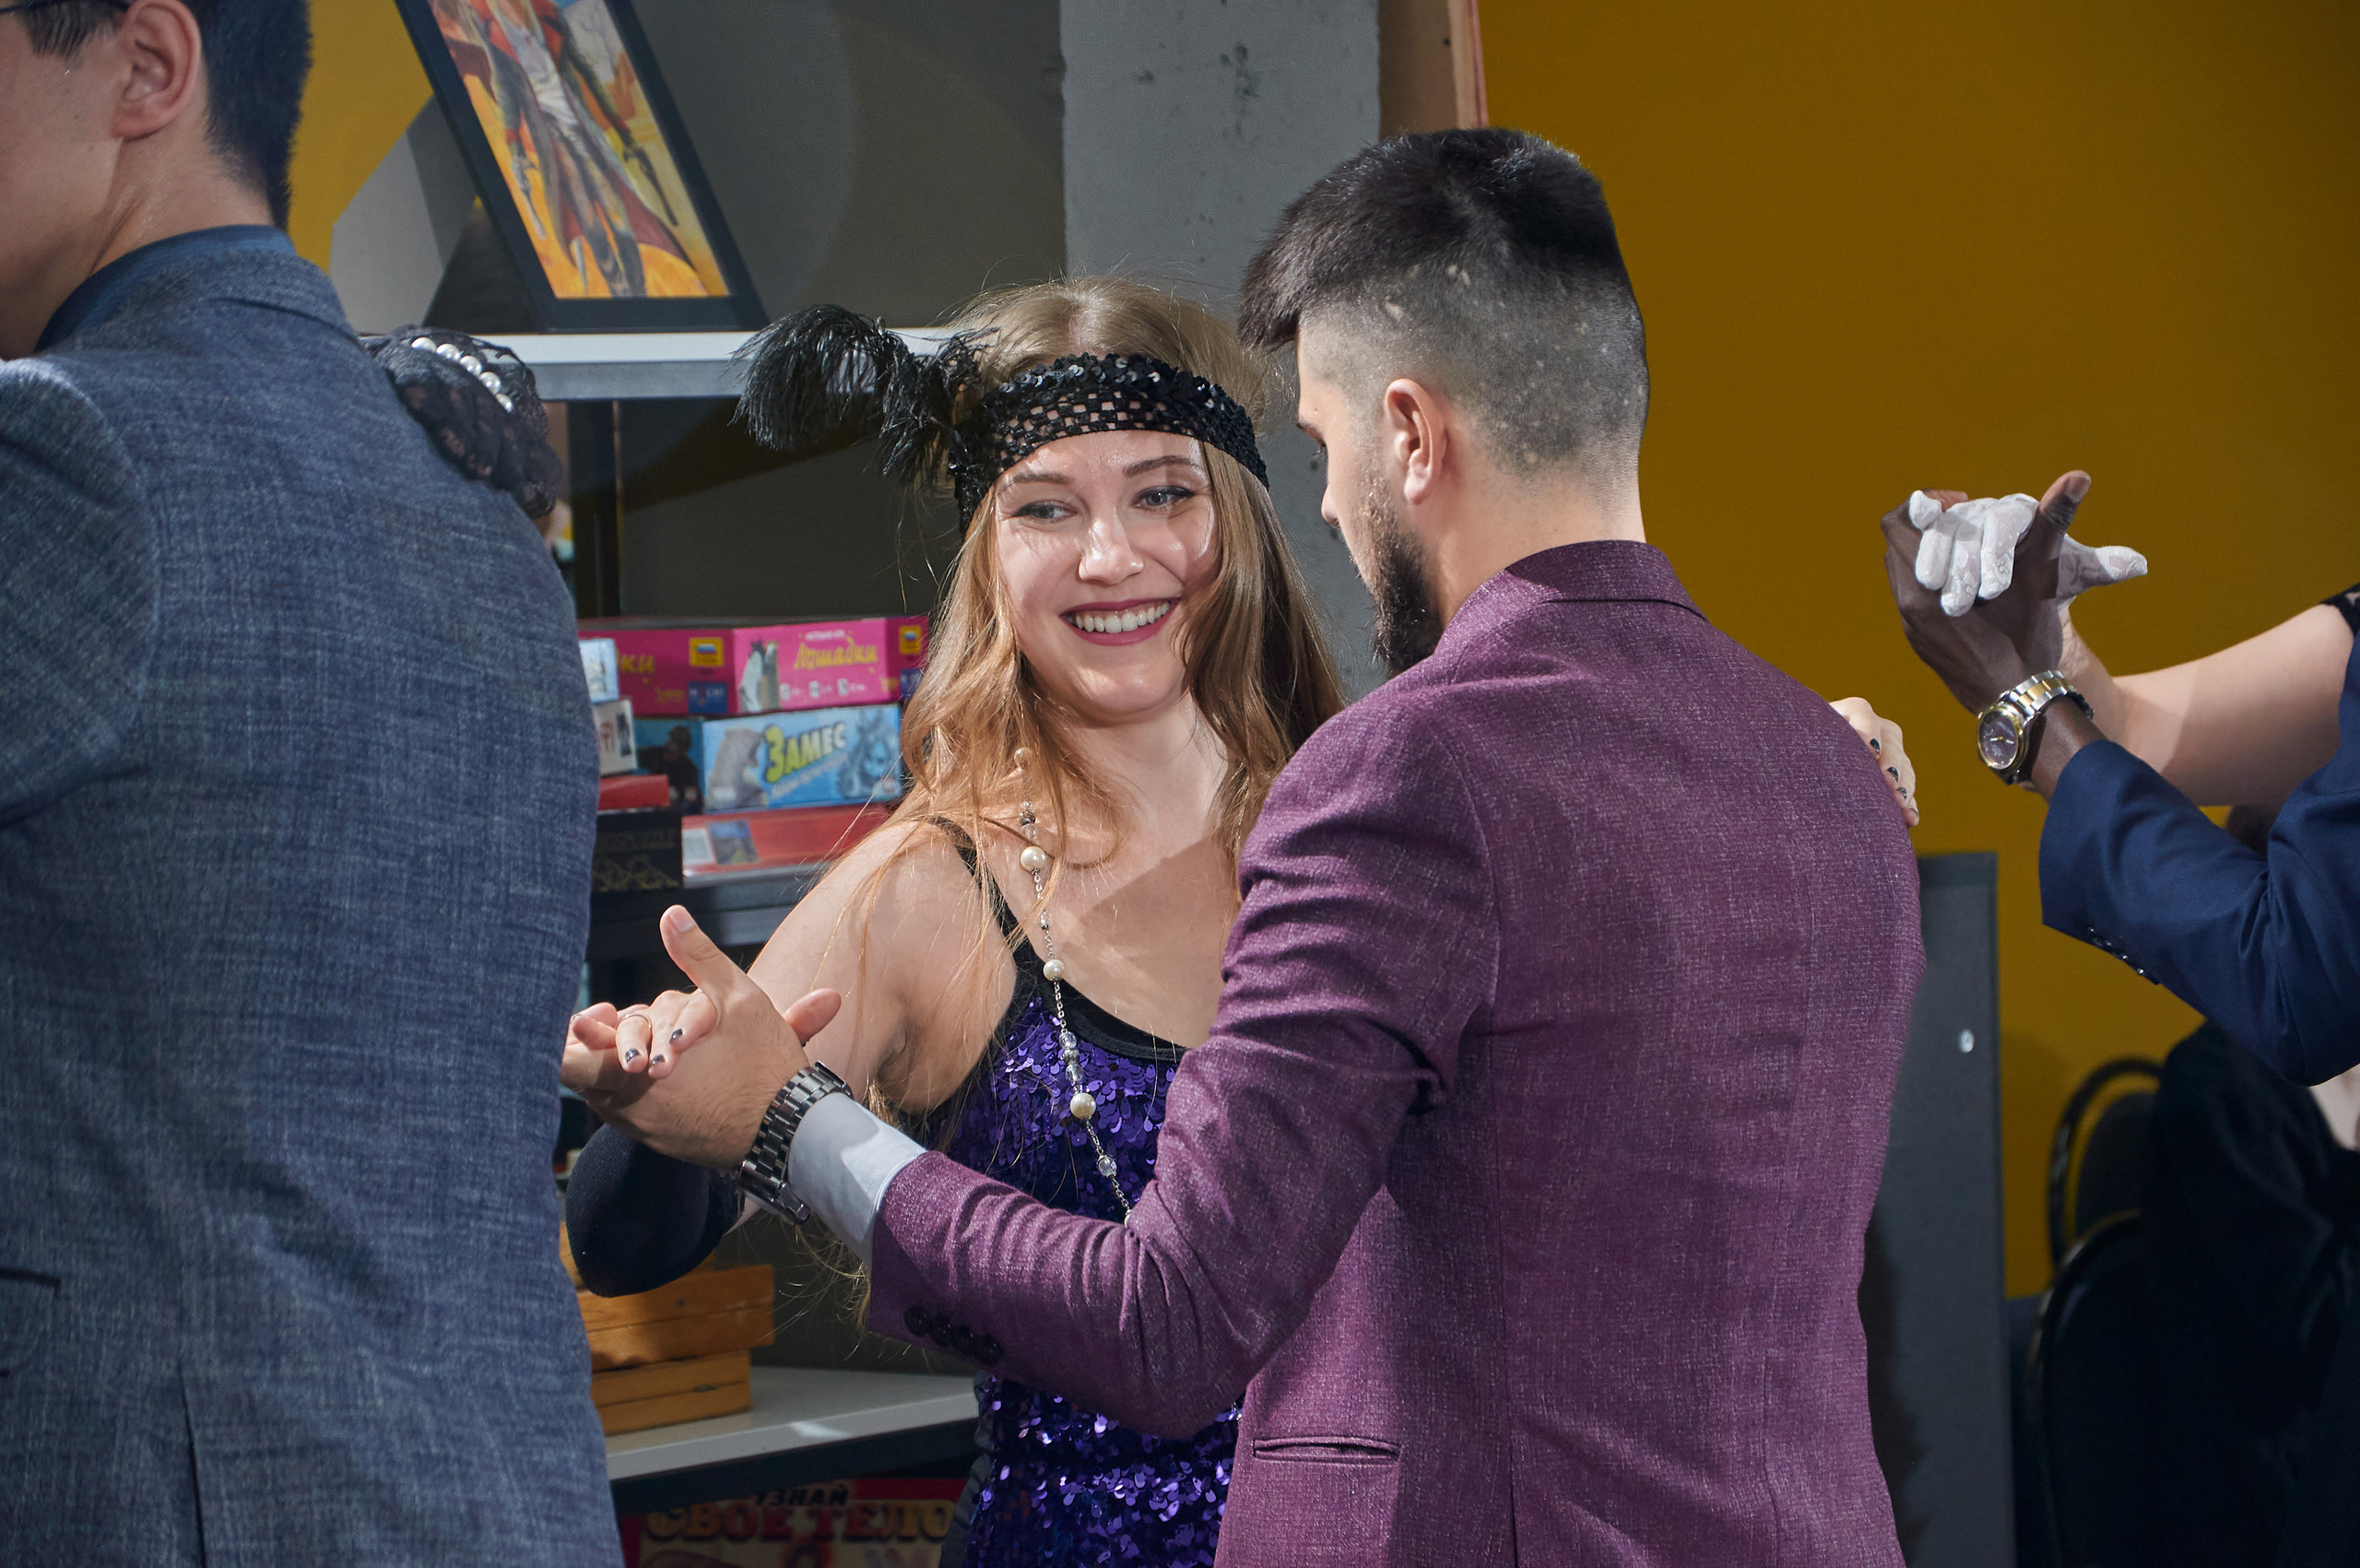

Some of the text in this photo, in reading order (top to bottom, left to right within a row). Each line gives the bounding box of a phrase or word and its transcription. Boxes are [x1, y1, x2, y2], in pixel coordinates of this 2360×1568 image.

[793, 635, 879, 670] Лошадки
[764, 721, 849, 784] ЗАМЕС
[645, 1500, 954, 1539] СВОЕ ТЕЛО
